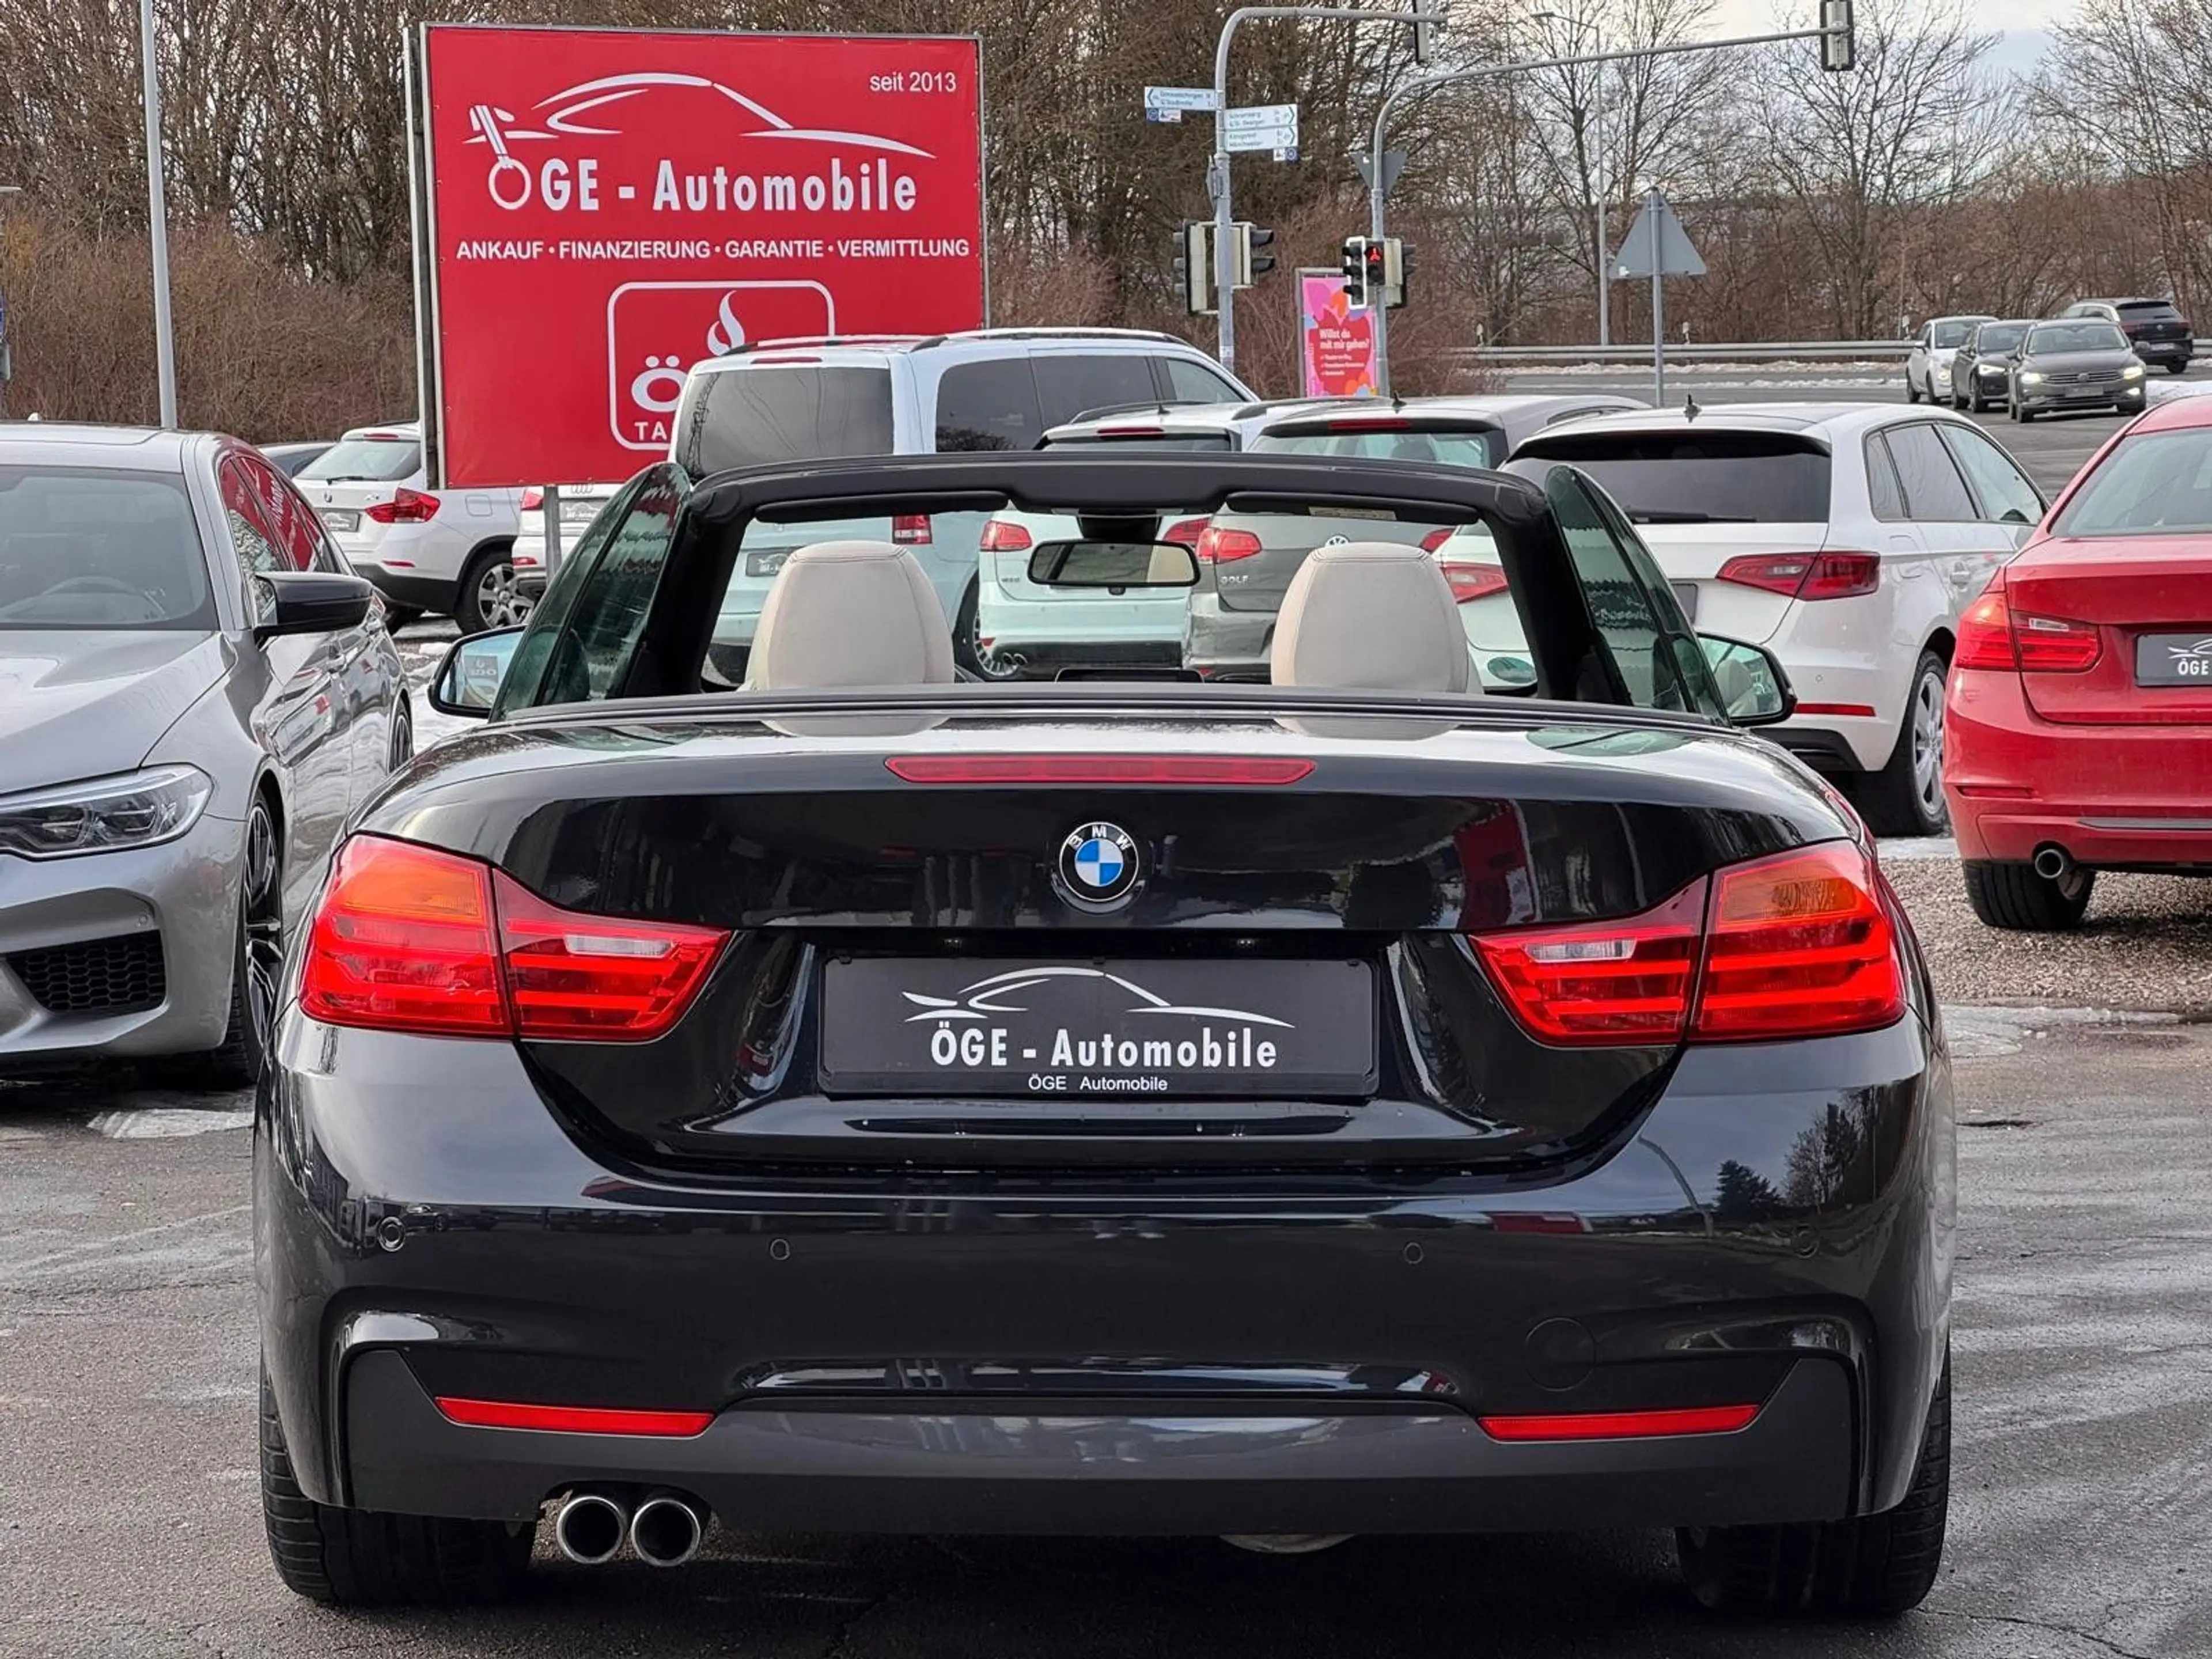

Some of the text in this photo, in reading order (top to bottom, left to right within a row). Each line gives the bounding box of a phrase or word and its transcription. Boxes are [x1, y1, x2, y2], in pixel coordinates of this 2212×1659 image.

[870, 71, 957, 92] seit 2013
[653, 157, 918, 211] Automobile
[456, 239, 969, 259] ANKAUF FINANZIERUNG GARANTIE VERMITTLUNG
[634, 421, 668, 441] TA
[1067, 824, 1132, 851] BMW
[931, 1021, 1008, 1066] ÖGE
[1051, 1027, 1277, 1067] Automobile
[1028, 1073, 1168, 1091] ÖGE Automobile
